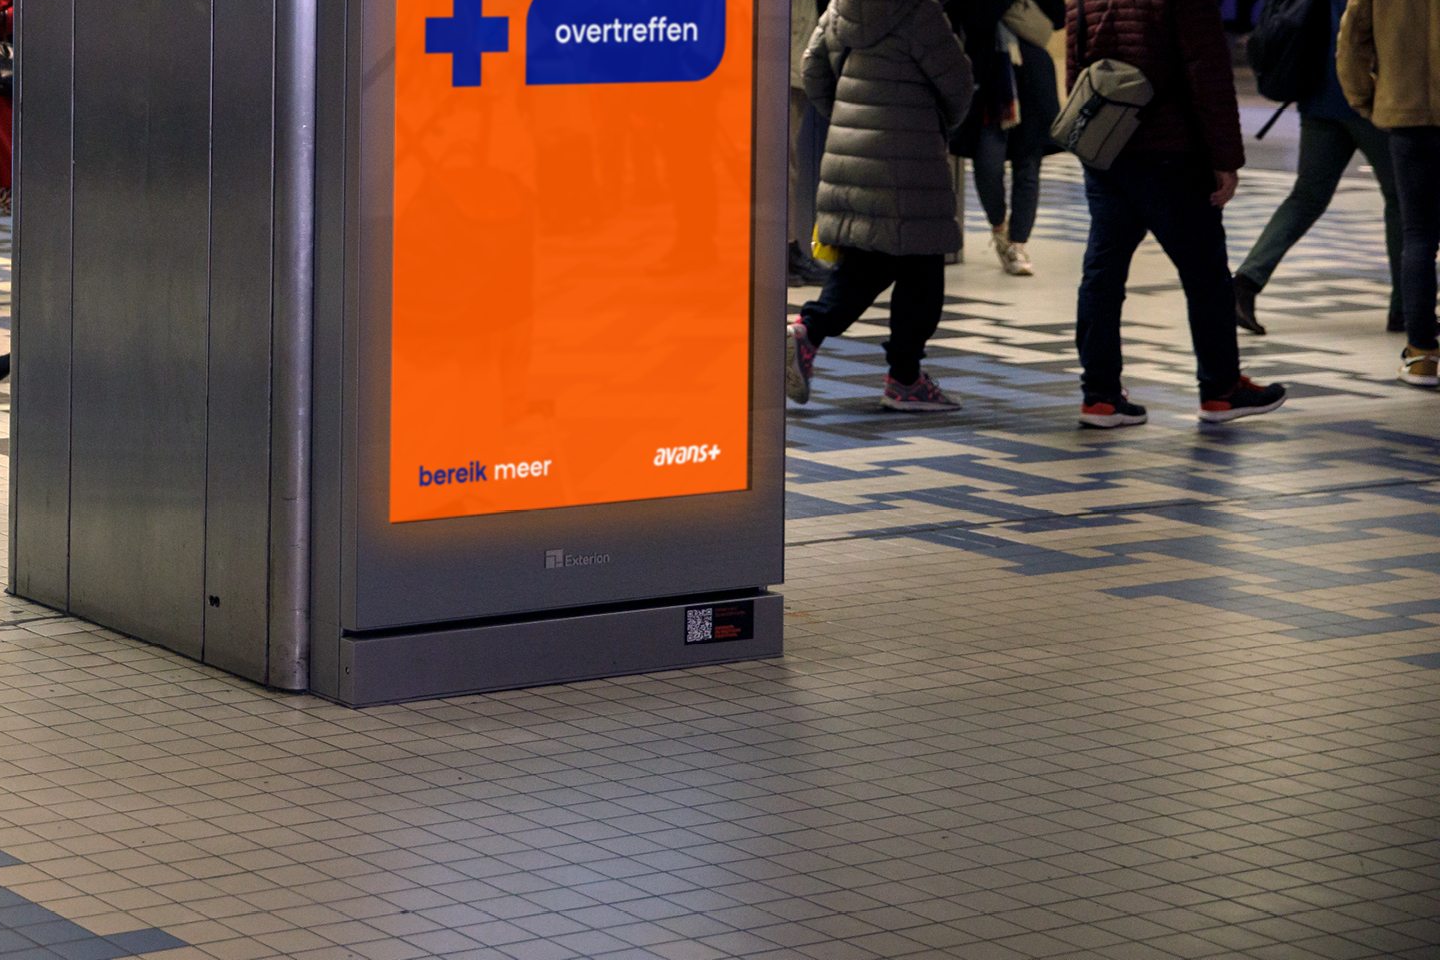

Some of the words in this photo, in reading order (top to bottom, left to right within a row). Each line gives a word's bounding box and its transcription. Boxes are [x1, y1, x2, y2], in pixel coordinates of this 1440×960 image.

[555, 16, 698, 44] overtreffen
[653, 443, 721, 467] avans+
[418, 461, 488, 486] bereik
[494, 459, 552, 480] meer
[564, 552, 610, 567] Exterion
